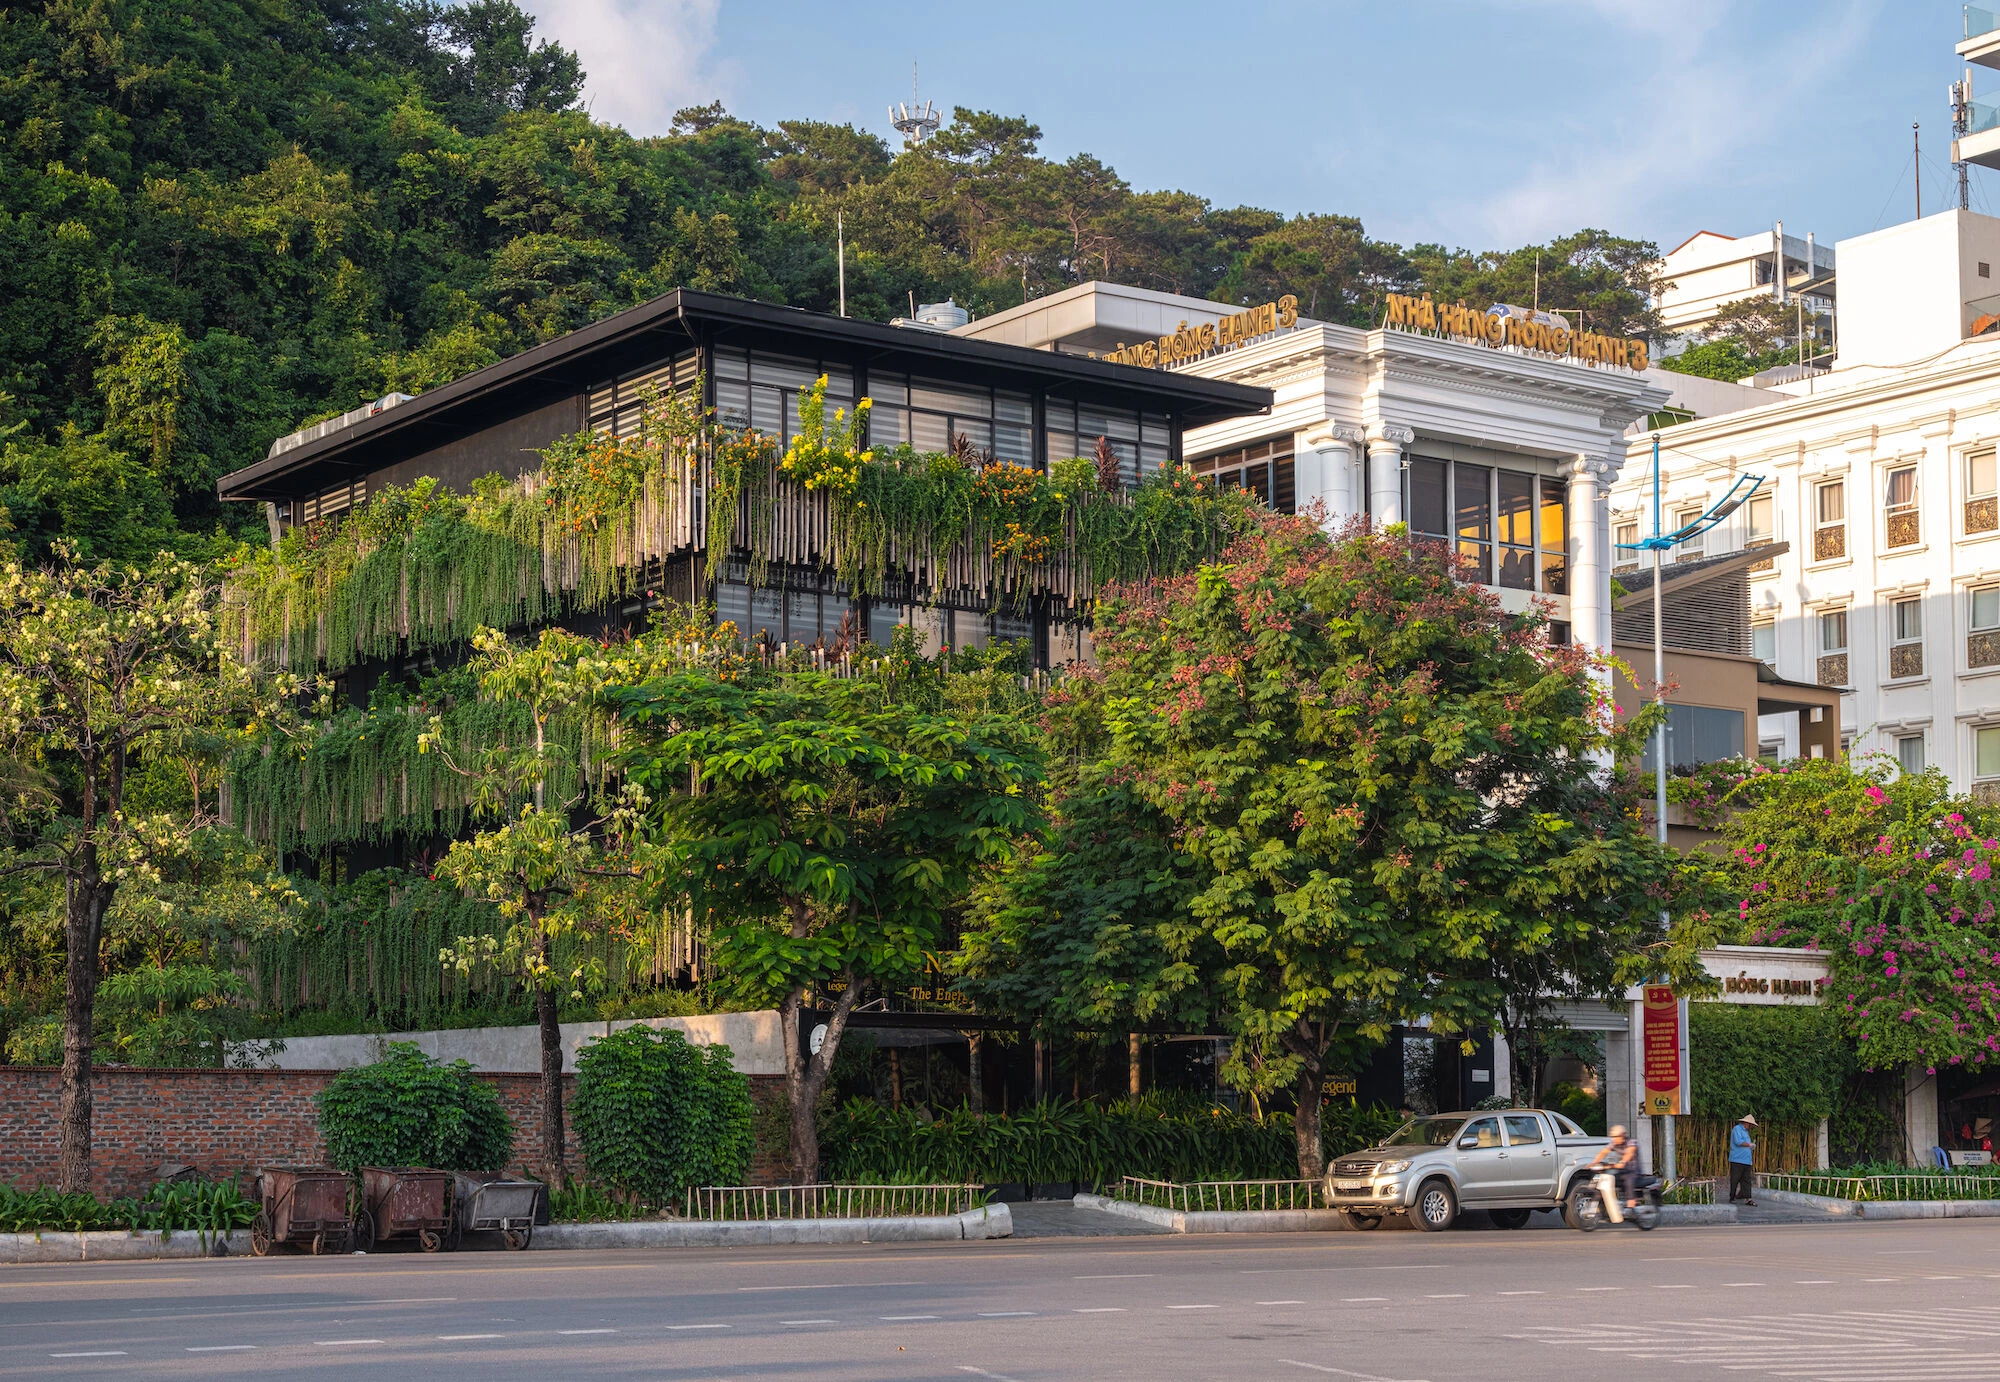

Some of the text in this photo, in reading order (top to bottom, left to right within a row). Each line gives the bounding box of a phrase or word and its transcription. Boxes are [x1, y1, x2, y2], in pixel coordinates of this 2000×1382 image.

[1278, 294, 1299, 328] 3
[1628, 339, 1648, 371] 3
[909, 986, 931, 1001] The
[1320, 1079, 1357, 1097] egend
